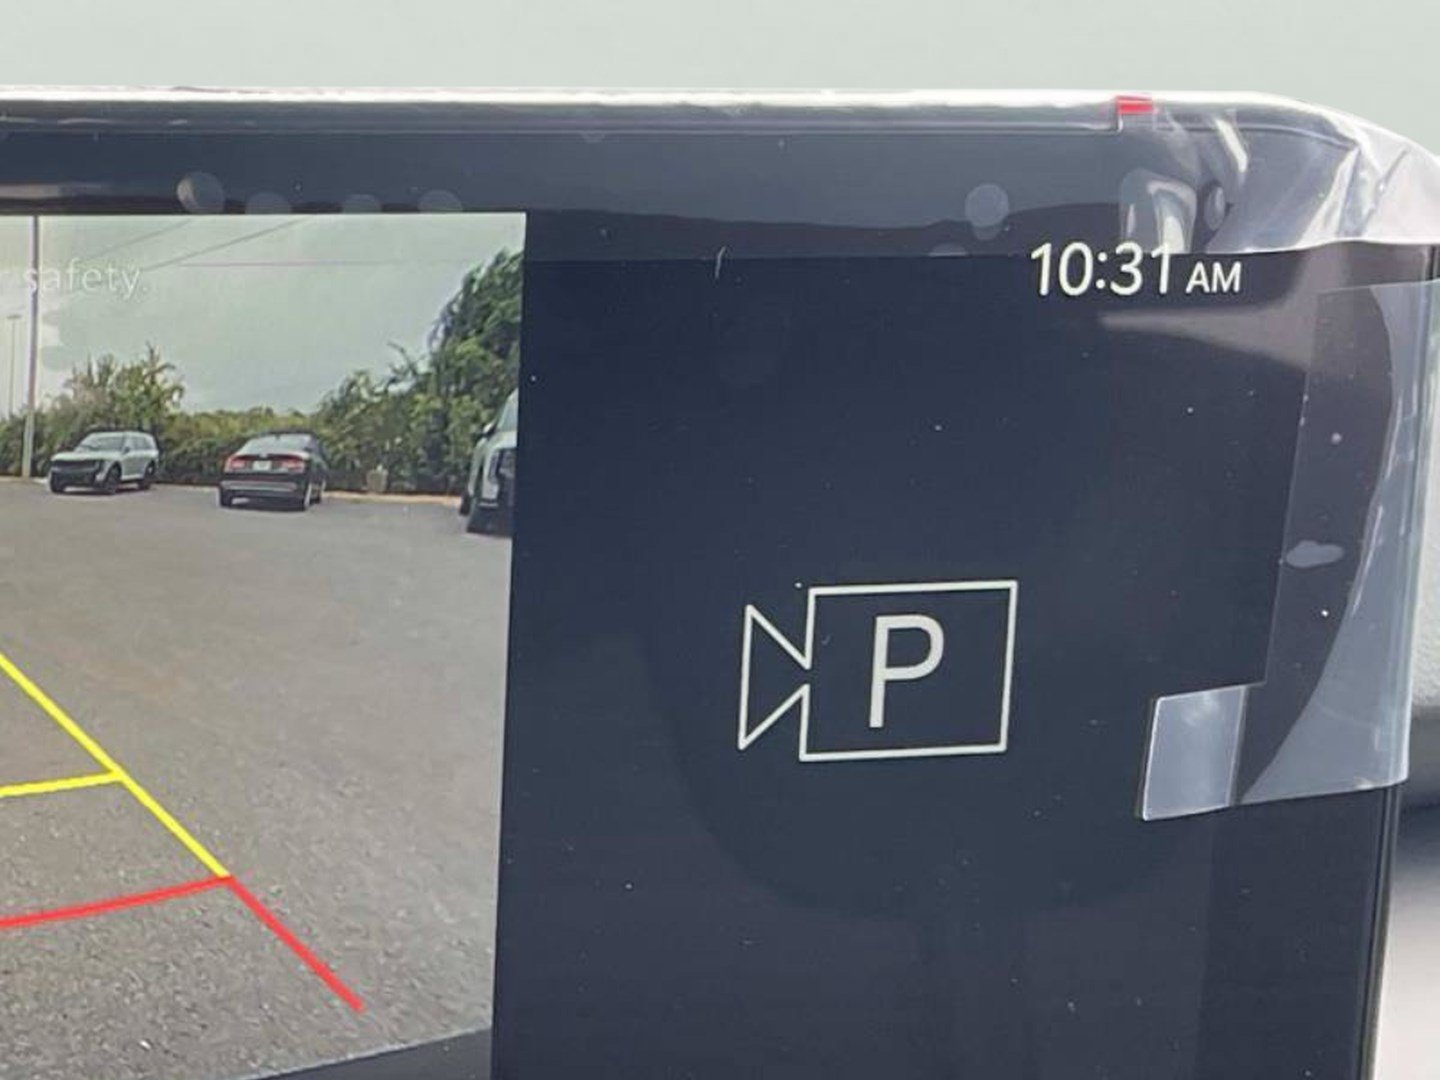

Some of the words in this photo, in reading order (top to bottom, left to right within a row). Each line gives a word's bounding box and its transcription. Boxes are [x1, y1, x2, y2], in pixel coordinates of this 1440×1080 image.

[1030, 241, 1171, 296] 10:31
[1185, 261, 1243, 294] AM
[869, 614, 945, 728] P
